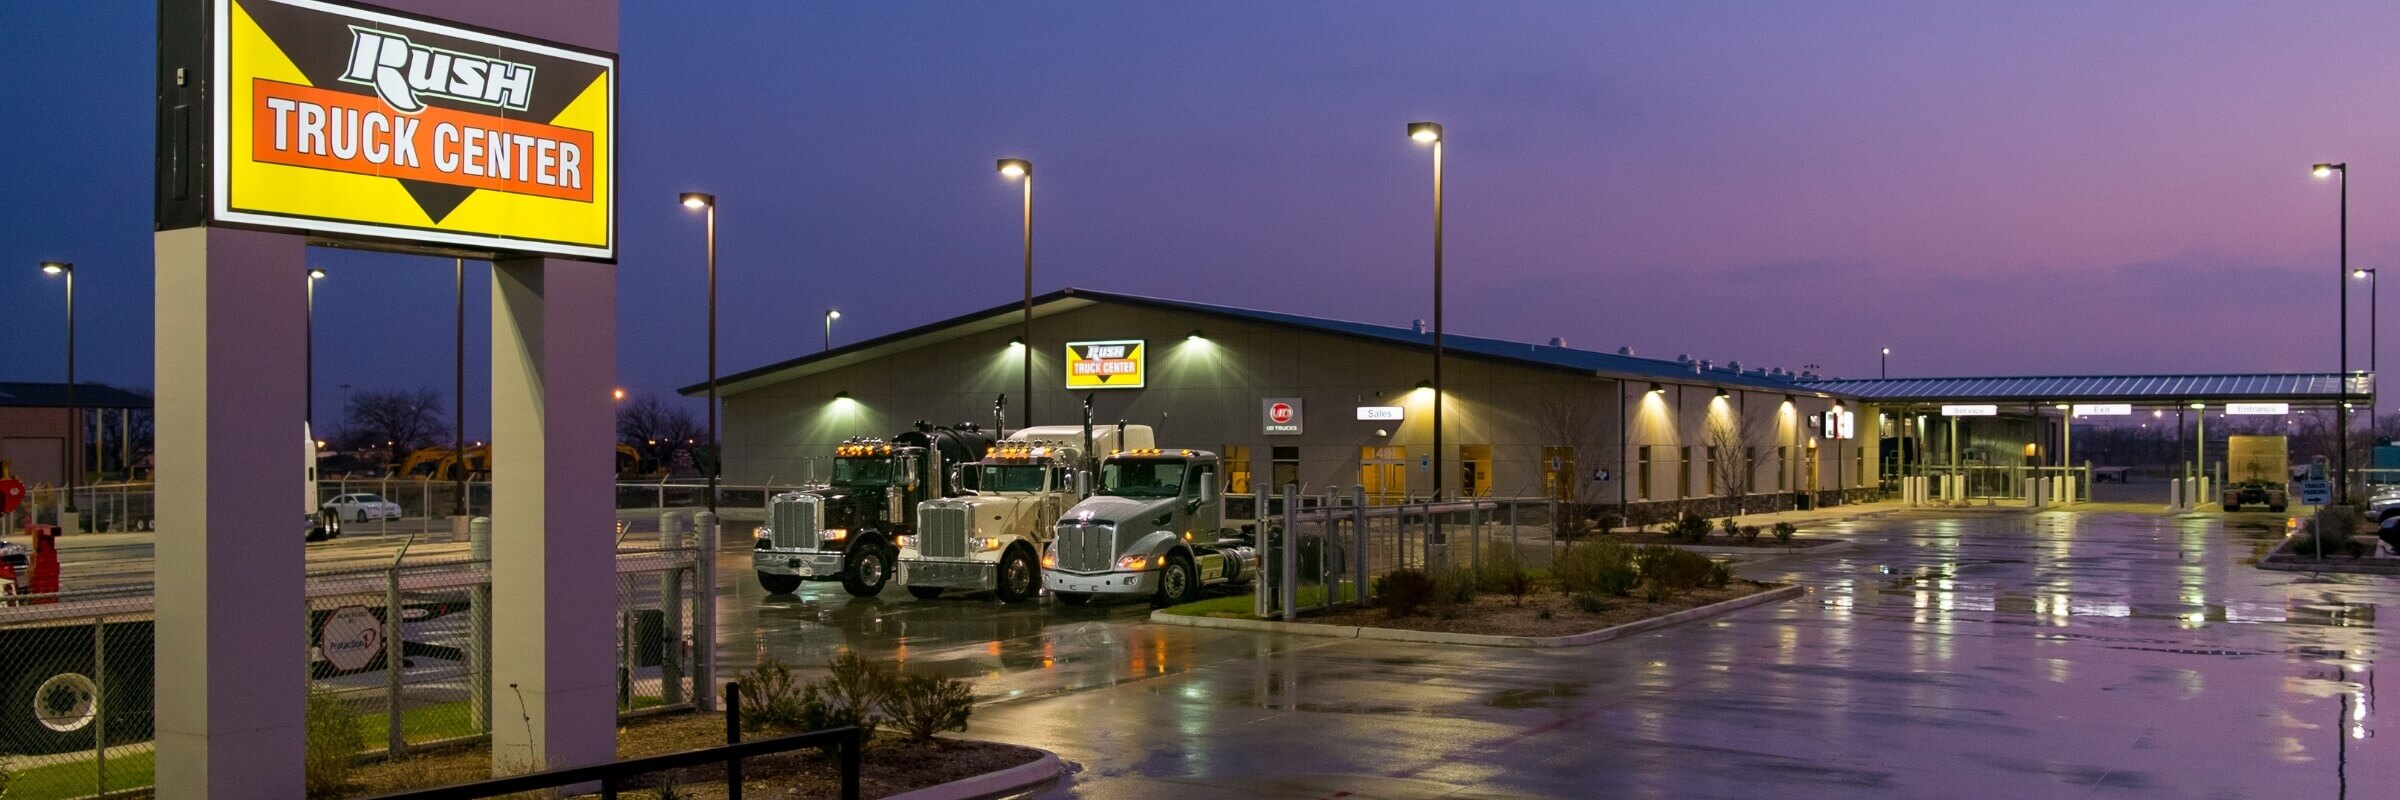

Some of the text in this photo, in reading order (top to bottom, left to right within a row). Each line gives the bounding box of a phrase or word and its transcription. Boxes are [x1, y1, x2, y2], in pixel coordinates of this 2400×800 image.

[267, 98, 582, 190] TRUCK CENTER
[1074, 361, 1135, 374] TRUCK CENTER
[1368, 409, 1392, 418] Sales
